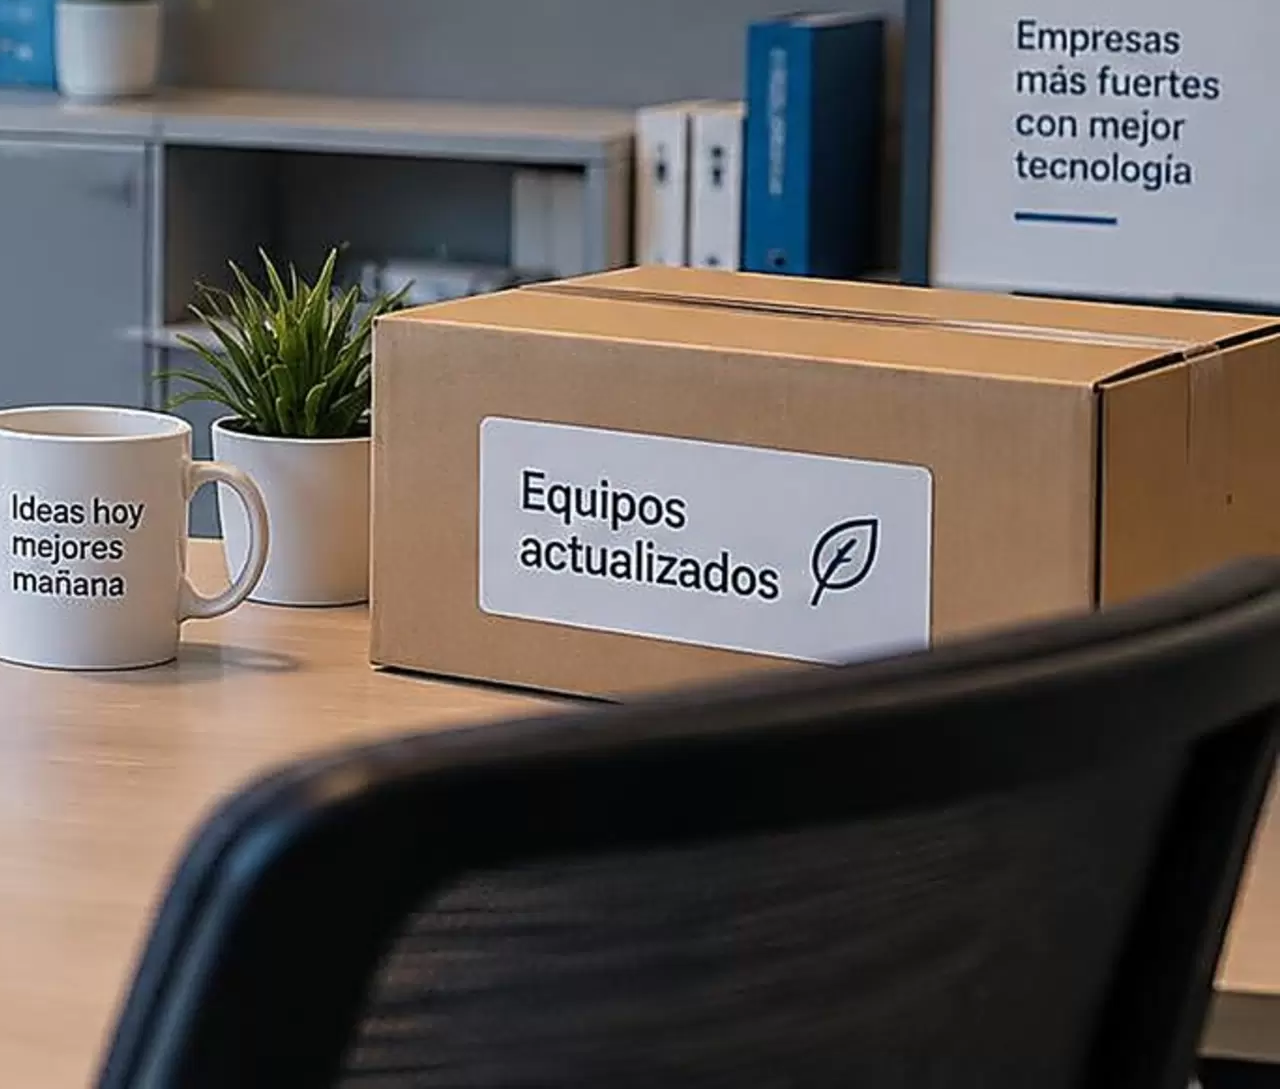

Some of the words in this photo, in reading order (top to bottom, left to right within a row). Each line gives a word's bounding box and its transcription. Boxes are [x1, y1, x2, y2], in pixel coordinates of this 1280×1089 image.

[1017, 19, 1180, 58] Empresas
[1016, 64, 1087, 96] más
[1098, 65, 1220, 101] fuertes
[1016, 113, 1077, 138] con
[1089, 109, 1185, 148] mejor
[1015, 150, 1192, 191] tecnología
[12, 493, 85, 525] Ideas
[93, 497, 145, 530] hoy
[522, 470, 685, 531] Equipos
[13, 533, 124, 565] mejores
[520, 535, 779, 600] actualizados
[13, 569, 125, 597] mañana
